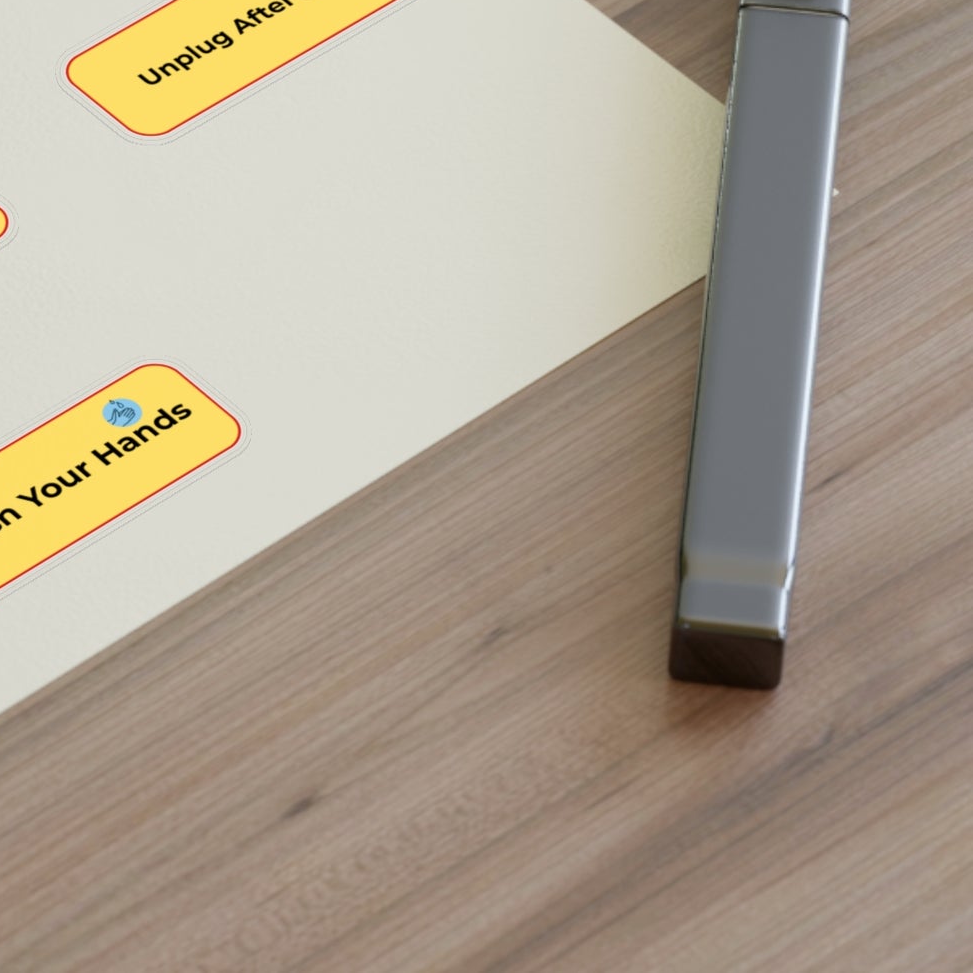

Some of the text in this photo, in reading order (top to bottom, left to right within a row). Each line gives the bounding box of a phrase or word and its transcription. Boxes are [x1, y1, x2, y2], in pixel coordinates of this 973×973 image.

[137, 31, 234, 85] Unplug
[16, 461, 91, 507] Your
[91, 403, 192, 466] Hands
